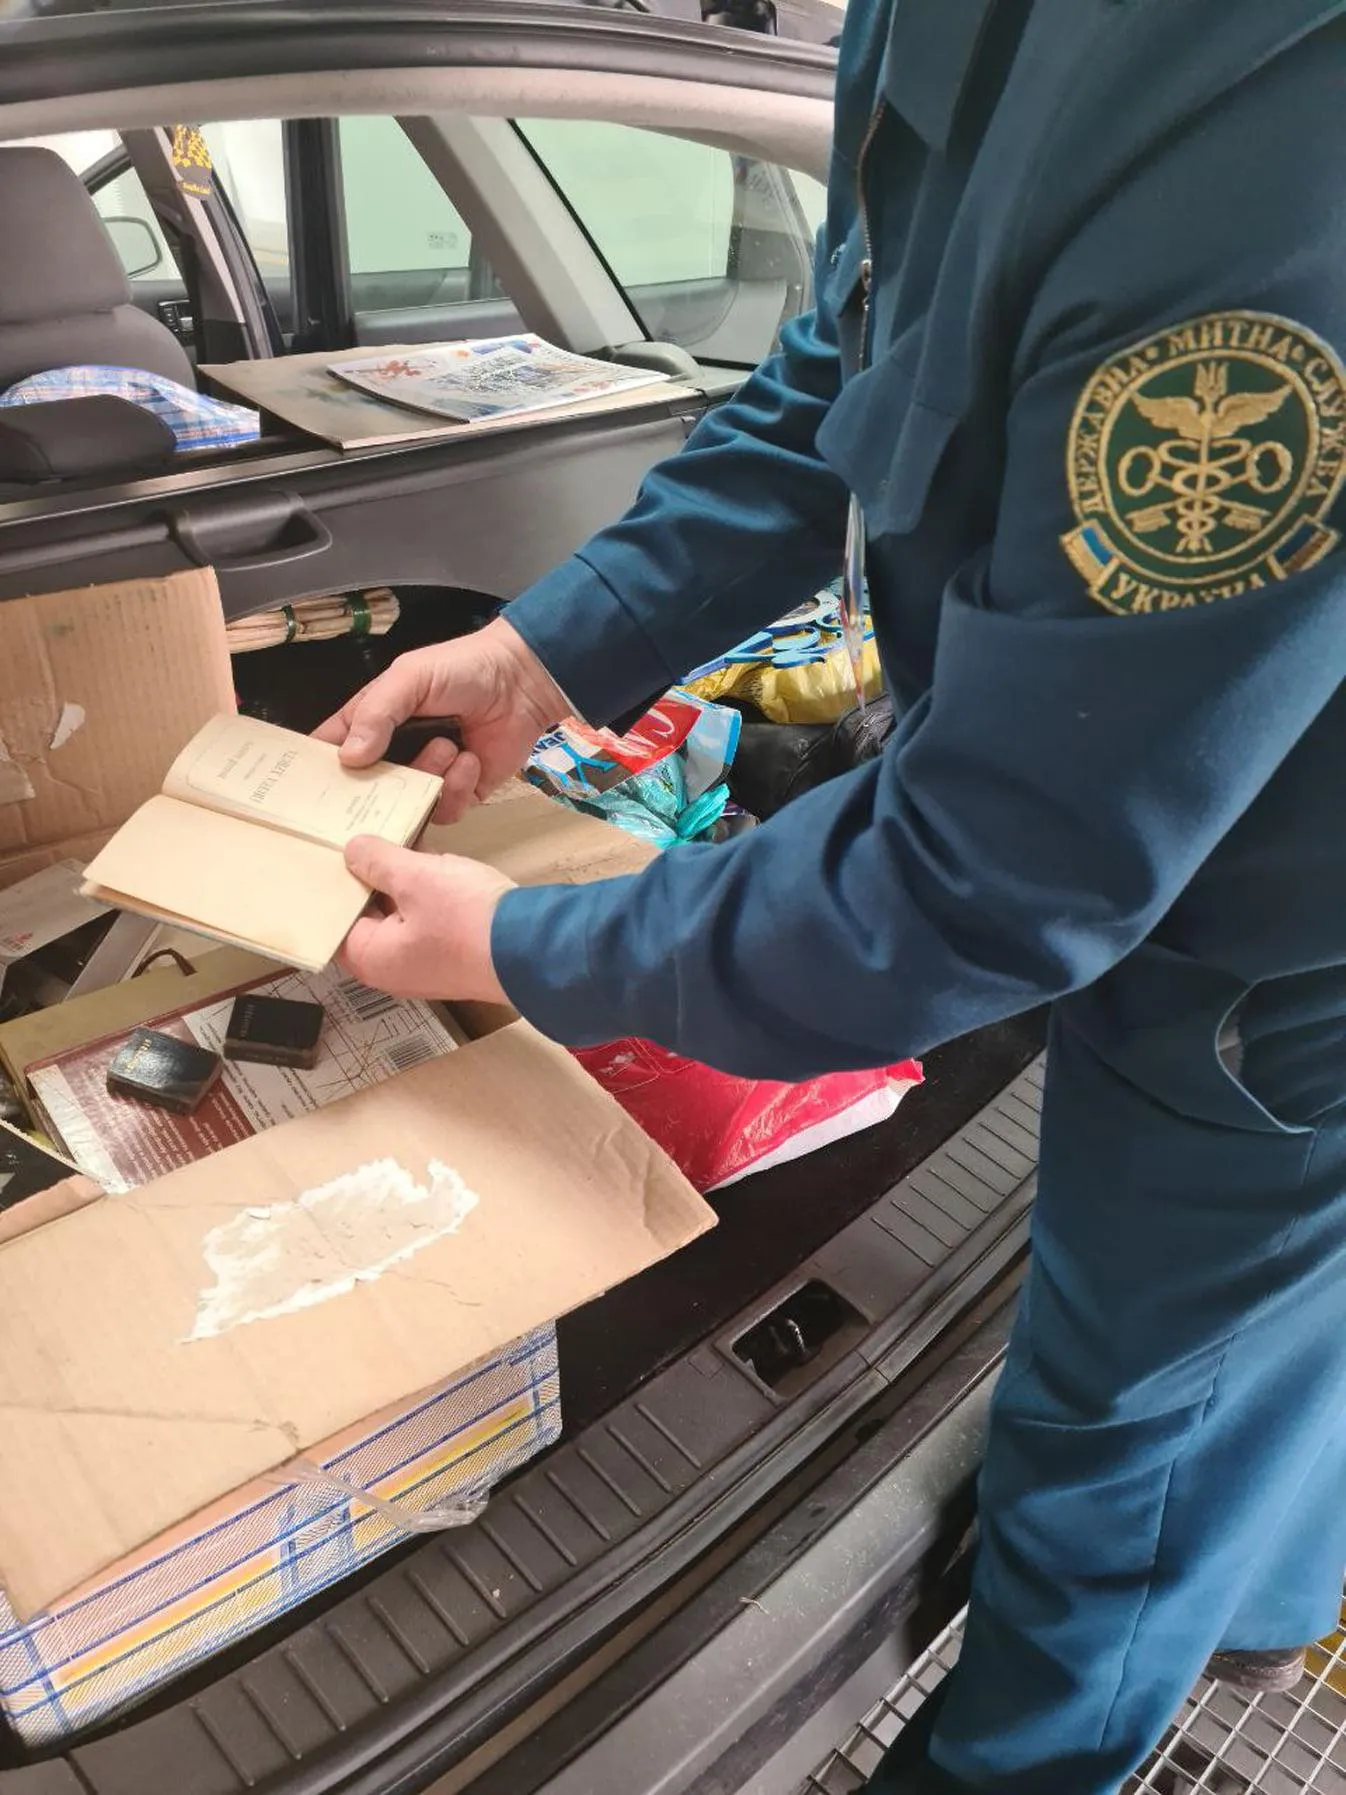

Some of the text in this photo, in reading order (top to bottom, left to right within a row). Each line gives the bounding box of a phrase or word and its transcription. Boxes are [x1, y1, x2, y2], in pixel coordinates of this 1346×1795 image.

[1076, 320, 1346, 514] ДЕРЖАВНА МИТНА СЛУЖБА
